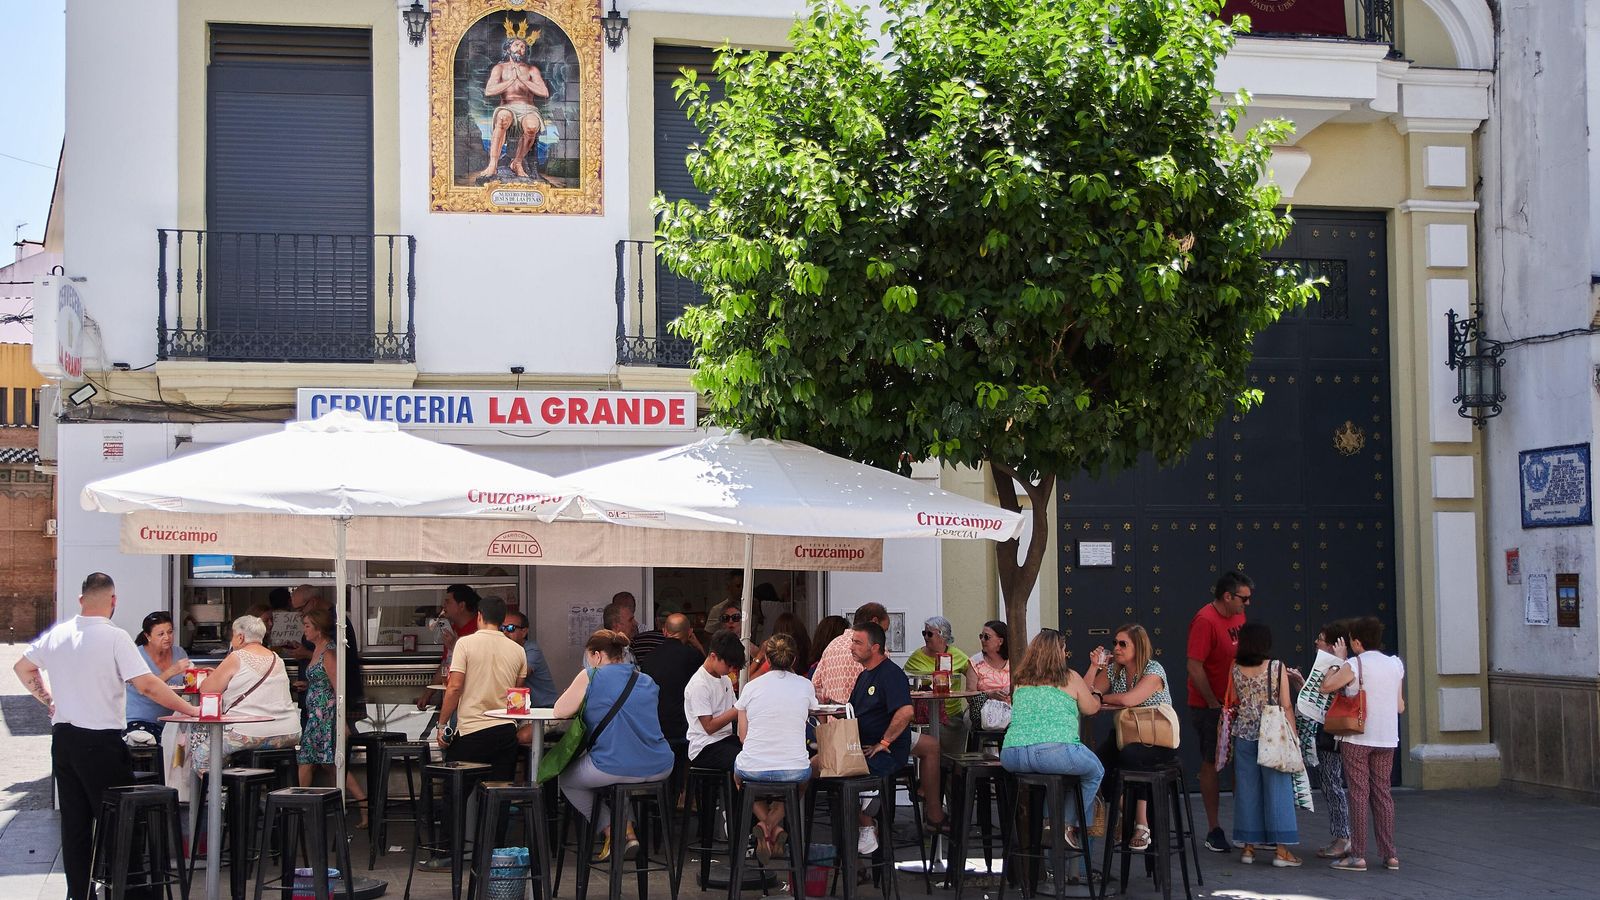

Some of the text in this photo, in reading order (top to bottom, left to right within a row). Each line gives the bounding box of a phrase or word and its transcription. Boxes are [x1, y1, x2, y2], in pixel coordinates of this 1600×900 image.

[311, 393, 685, 426] CERVECERIA LA GRANDE
[917, 511, 1003, 531] Cruzcampo
[139, 526, 218, 544] Cruzcampo
[492, 543, 539, 554] EMILIO
[794, 544, 865, 561] Cruzcampo
